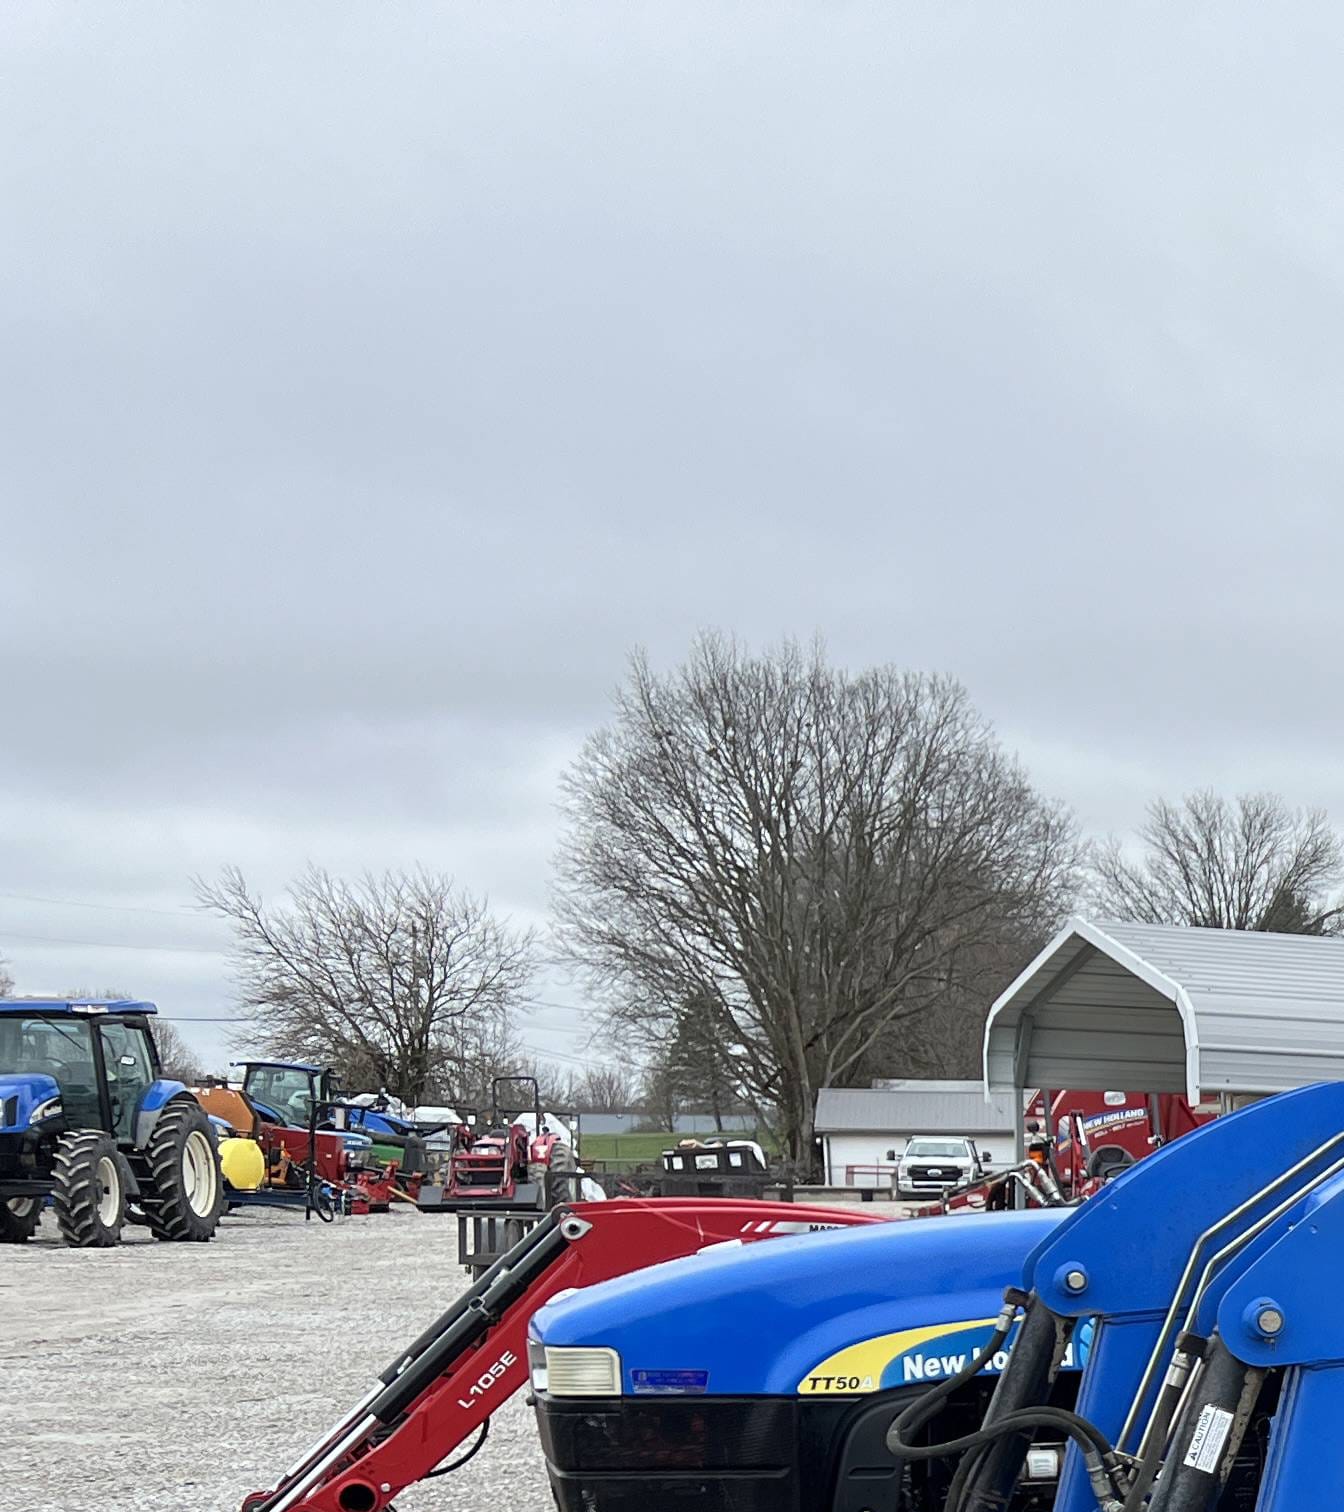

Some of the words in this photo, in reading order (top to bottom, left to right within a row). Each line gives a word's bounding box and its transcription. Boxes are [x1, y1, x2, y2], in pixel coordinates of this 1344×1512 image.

[1103, 1108, 1144, 1124] HOLLAND
[457, 1350, 517, 1409] L105E
[808, 1376, 873, 1391] TT50A
[904, 1351, 965, 1381] New
[1192, 1412, 1211, 1450] CAUTION
